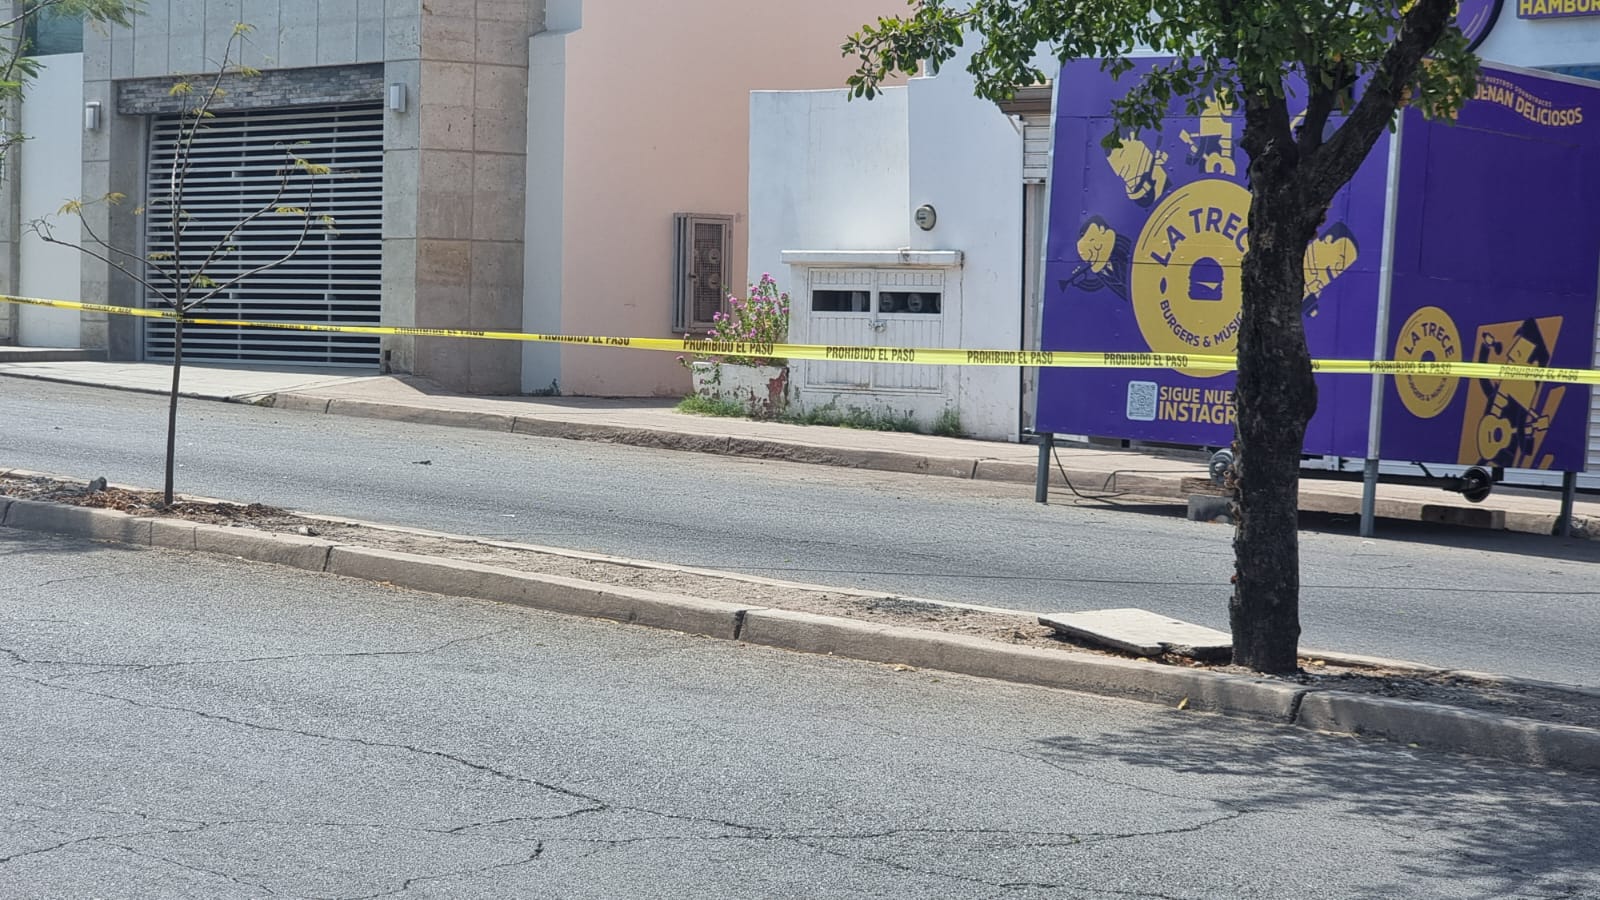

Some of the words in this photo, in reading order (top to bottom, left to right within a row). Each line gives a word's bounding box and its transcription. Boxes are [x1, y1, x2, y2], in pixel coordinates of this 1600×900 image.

[1474, 83, 1514, 107] UENAN
[1515, 96, 1583, 126] DELICIOSOS
[1150, 225, 1186, 267] LA
[1189, 207, 1249, 253] TREC
[1160, 300, 1200, 347] BURGERS
[1202, 336, 1211, 347] &
[1213, 312, 1242, 345] MÚSIC
[736, 341, 746, 354] EL
[749, 342, 774, 355] PASO
[1403, 331, 1420, 355] LA
[1421, 322, 1454, 358] TRECE
[826, 346, 875, 361] PROHIBIDO
[878, 348, 888, 361] EL
[891, 348, 915, 362] PASO
[967, 350, 1016, 364] PROHIBIDO
[1018, 351, 1028, 364] EL
[1030, 351, 1053, 365] PASO
[1104, 353, 1151, 366] PROHIBIDO
[1153, 354, 1163, 367] EL
[1166, 354, 1188, 368] PASO
[1160, 386, 1200, 403] SIGUE
[1204, 389, 1233, 405] NUE
[1158, 401, 1237, 425] INSTAGR
